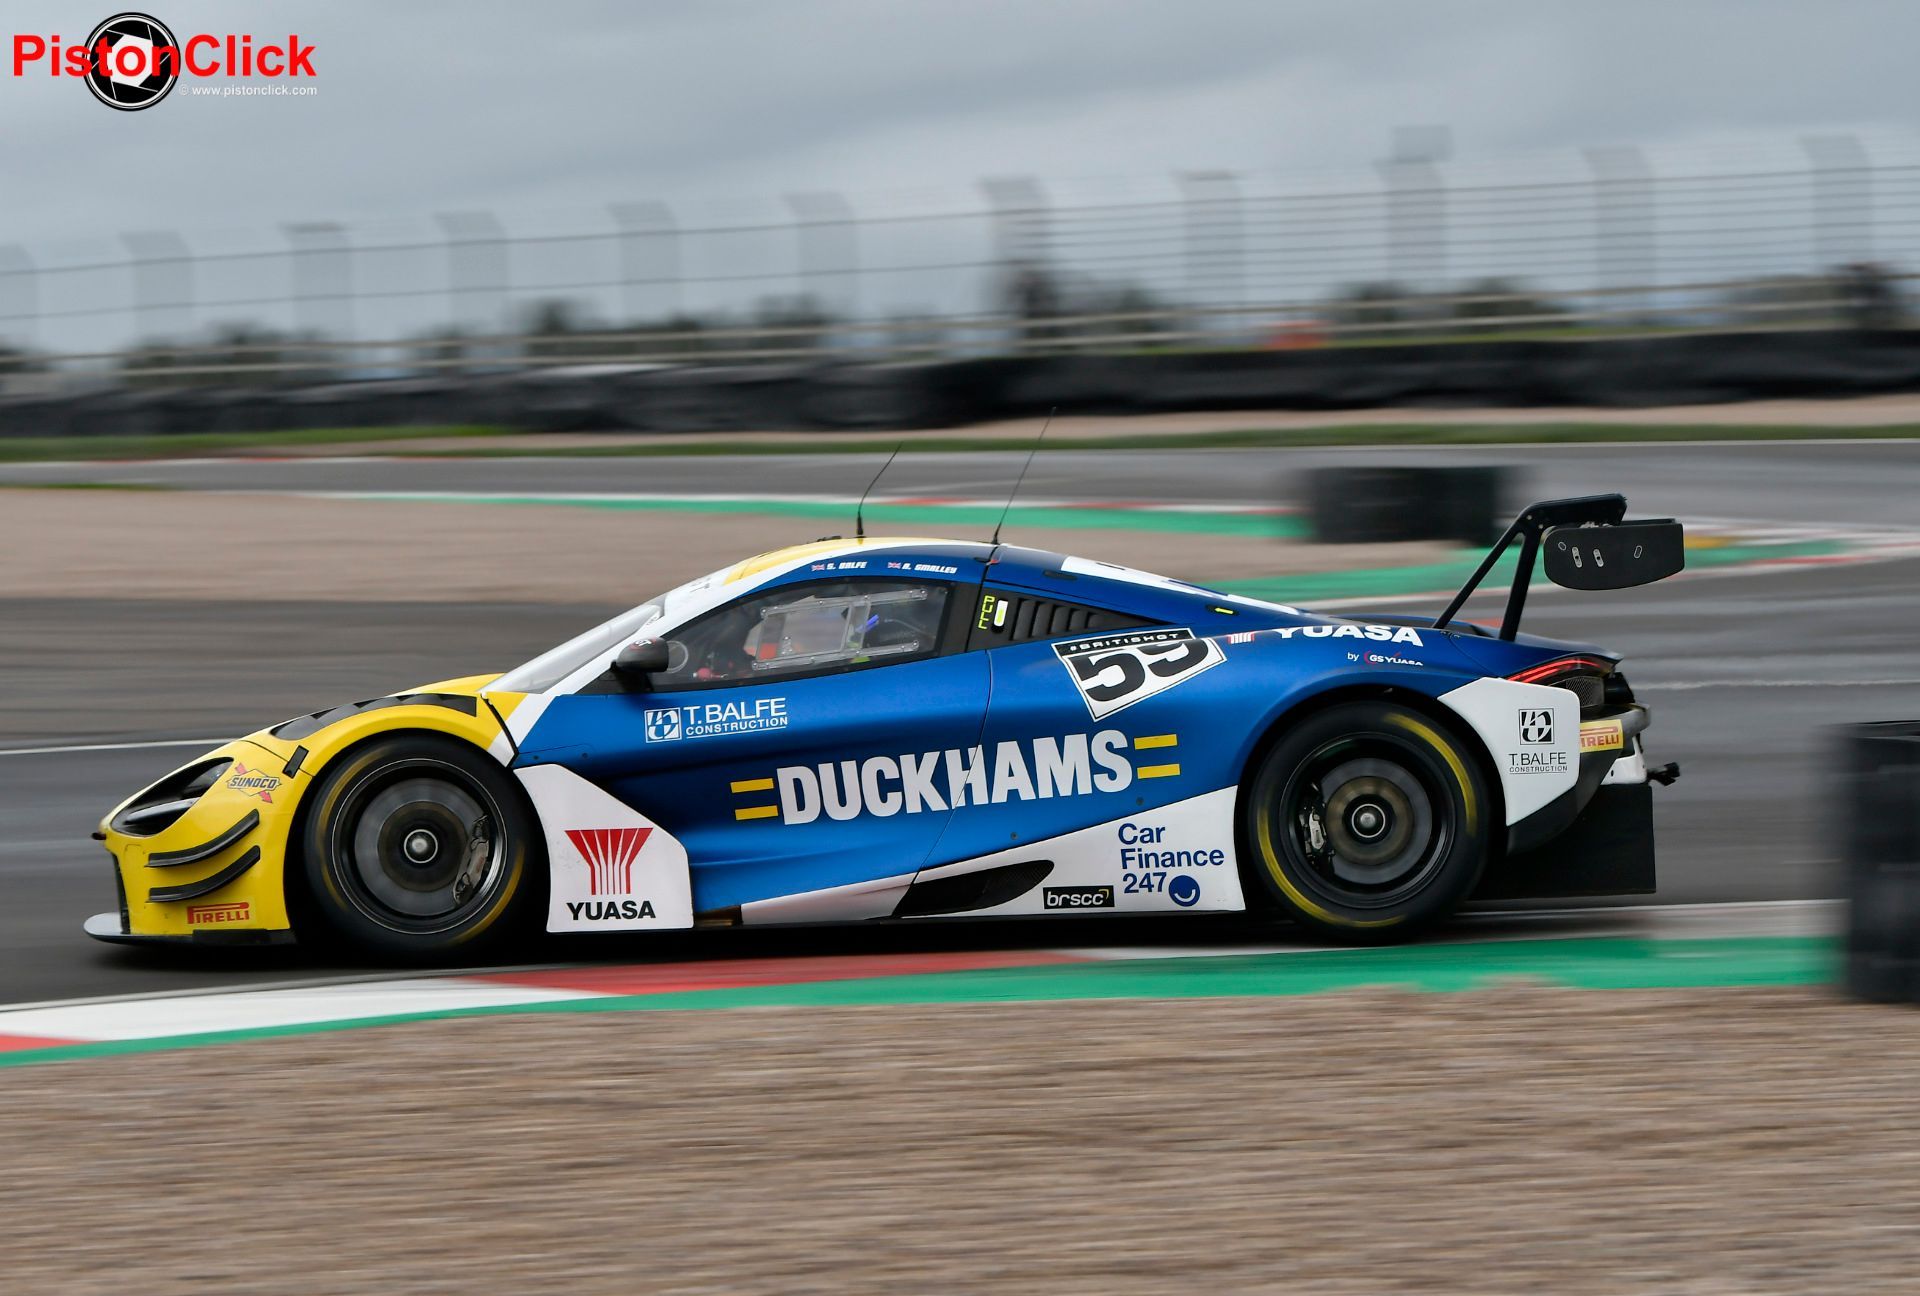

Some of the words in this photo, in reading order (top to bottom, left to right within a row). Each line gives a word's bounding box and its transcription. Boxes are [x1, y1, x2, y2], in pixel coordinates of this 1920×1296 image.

[839, 561, 868, 570] BALFE
[914, 563, 958, 574] SMALLEY
[978, 595, 995, 629] PULL
[1272, 625, 1424, 647] YUASA
[1347, 652, 1359, 662] by
[686, 717, 788, 736] CONSTRUCTION
[230, 777, 278, 789] SUNOCO
[776, 729, 1133, 826] DUCKHAMS
[1118, 823, 1166, 845] Car
[1120, 848, 1225, 870] Finance
[1122, 871, 1167, 894] 247
[1046, 891, 1104, 907] brscc
[187, 902, 249, 924] PIRELLI
[566, 900, 656, 920] YUASA
